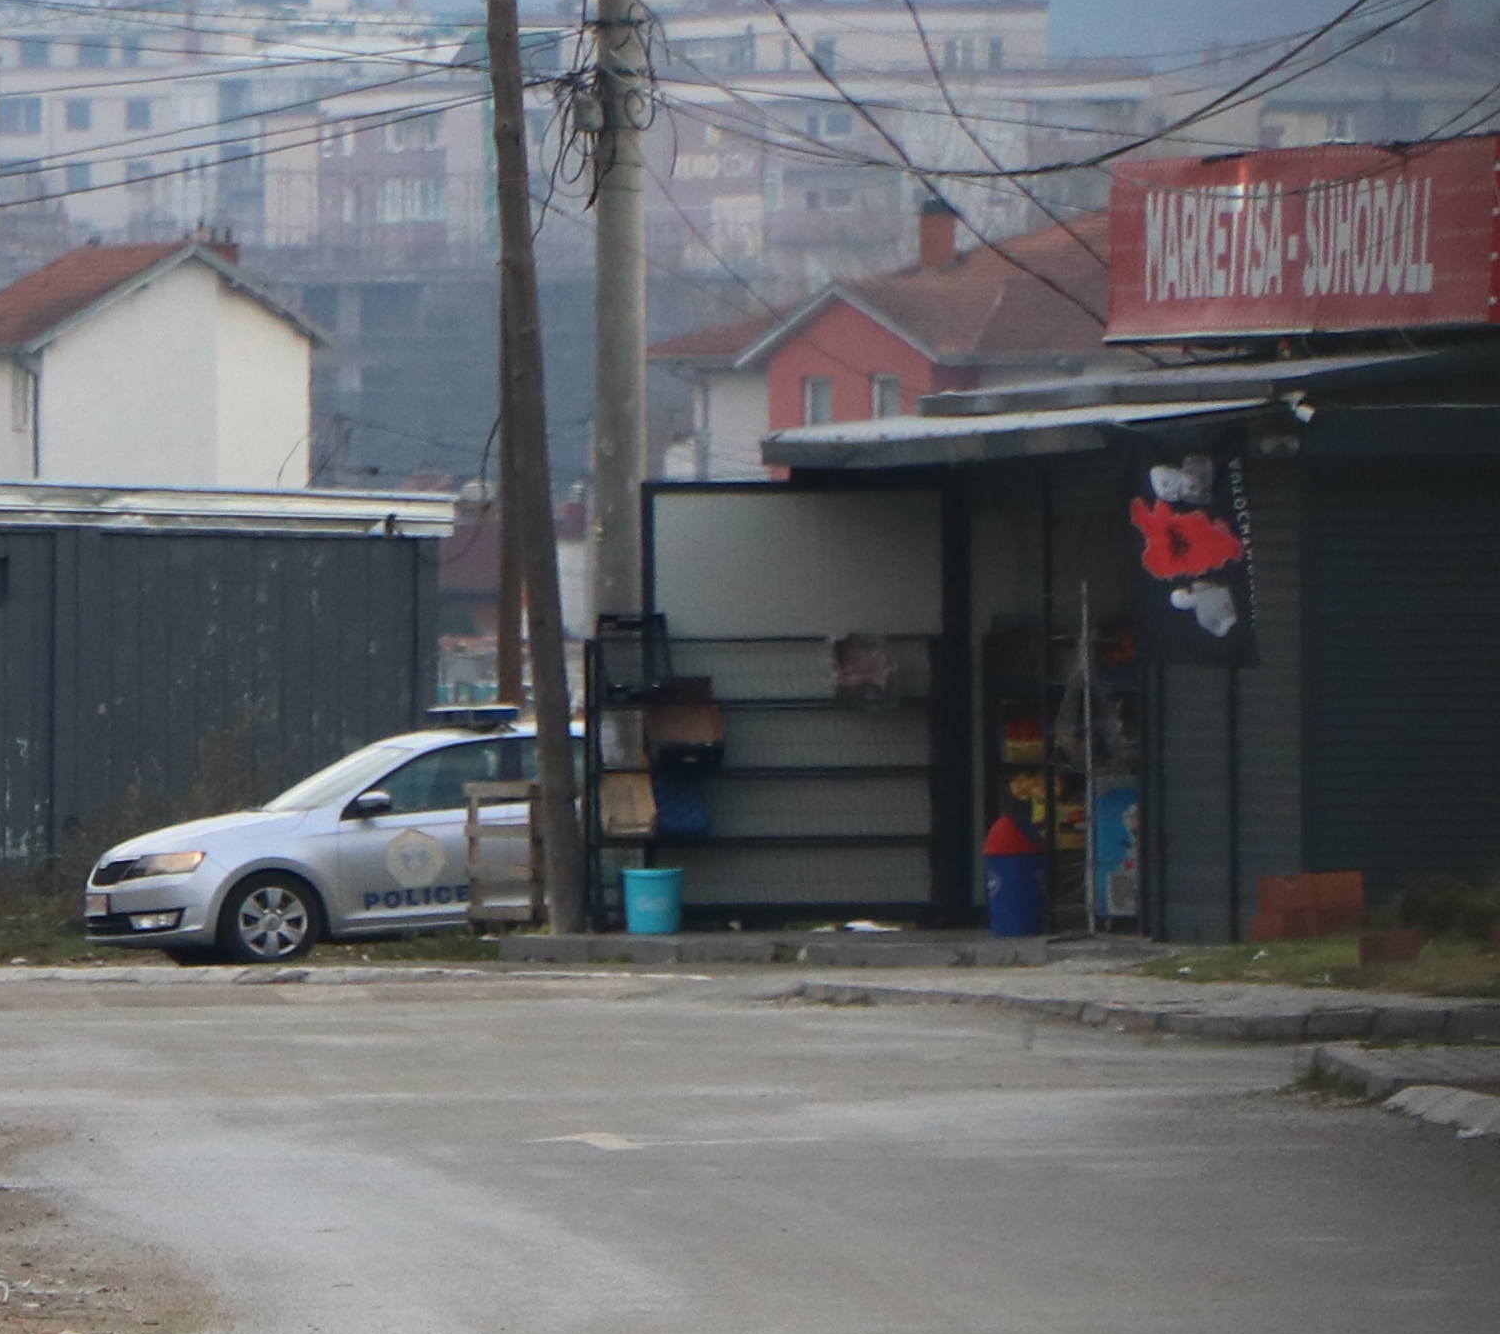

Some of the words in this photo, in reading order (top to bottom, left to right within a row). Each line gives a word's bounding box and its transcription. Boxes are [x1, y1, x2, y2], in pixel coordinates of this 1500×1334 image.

[1145, 183, 1244, 302] MARKET
[1303, 176, 1434, 297] SUHODOLL
[364, 885, 470, 910] POLICE
